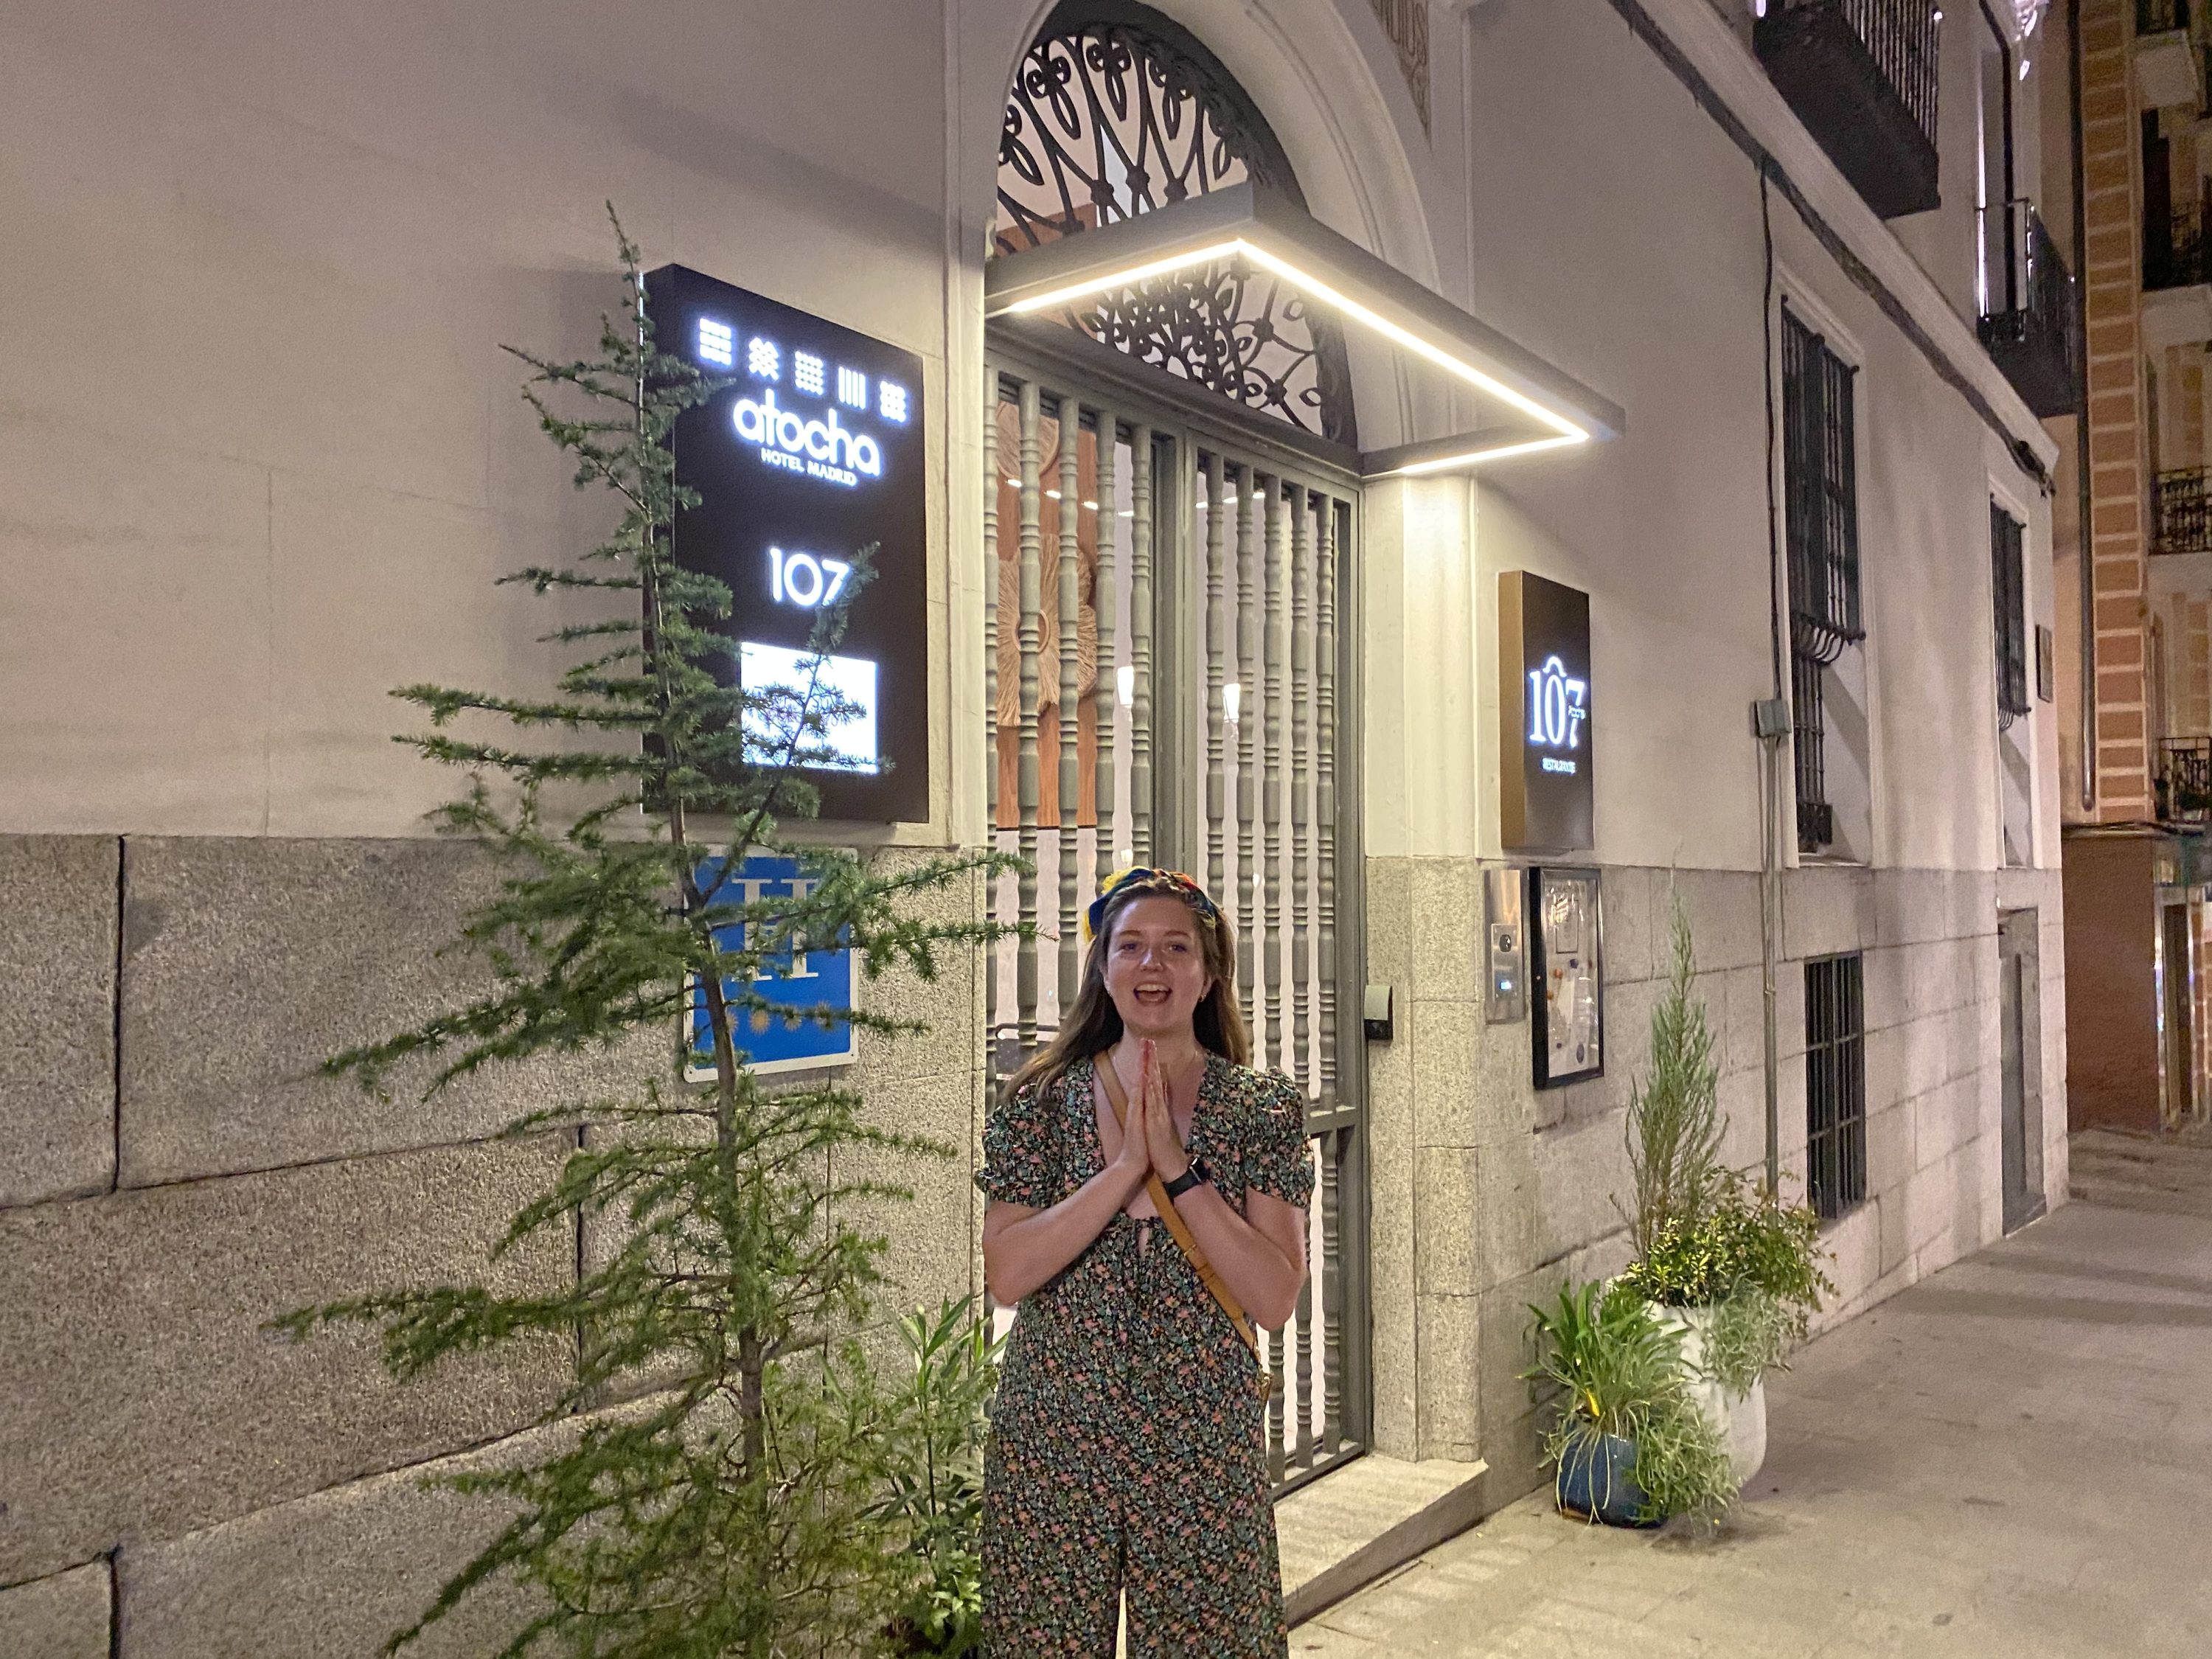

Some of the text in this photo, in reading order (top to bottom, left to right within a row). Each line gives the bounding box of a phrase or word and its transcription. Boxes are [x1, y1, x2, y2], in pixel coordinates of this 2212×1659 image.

[733, 389, 881, 477] atocha
[761, 448, 858, 487] HOTEL MADRID
[770, 546, 851, 607] 107
[1529, 671, 1585, 748] 107
[731, 878, 819, 982] H
